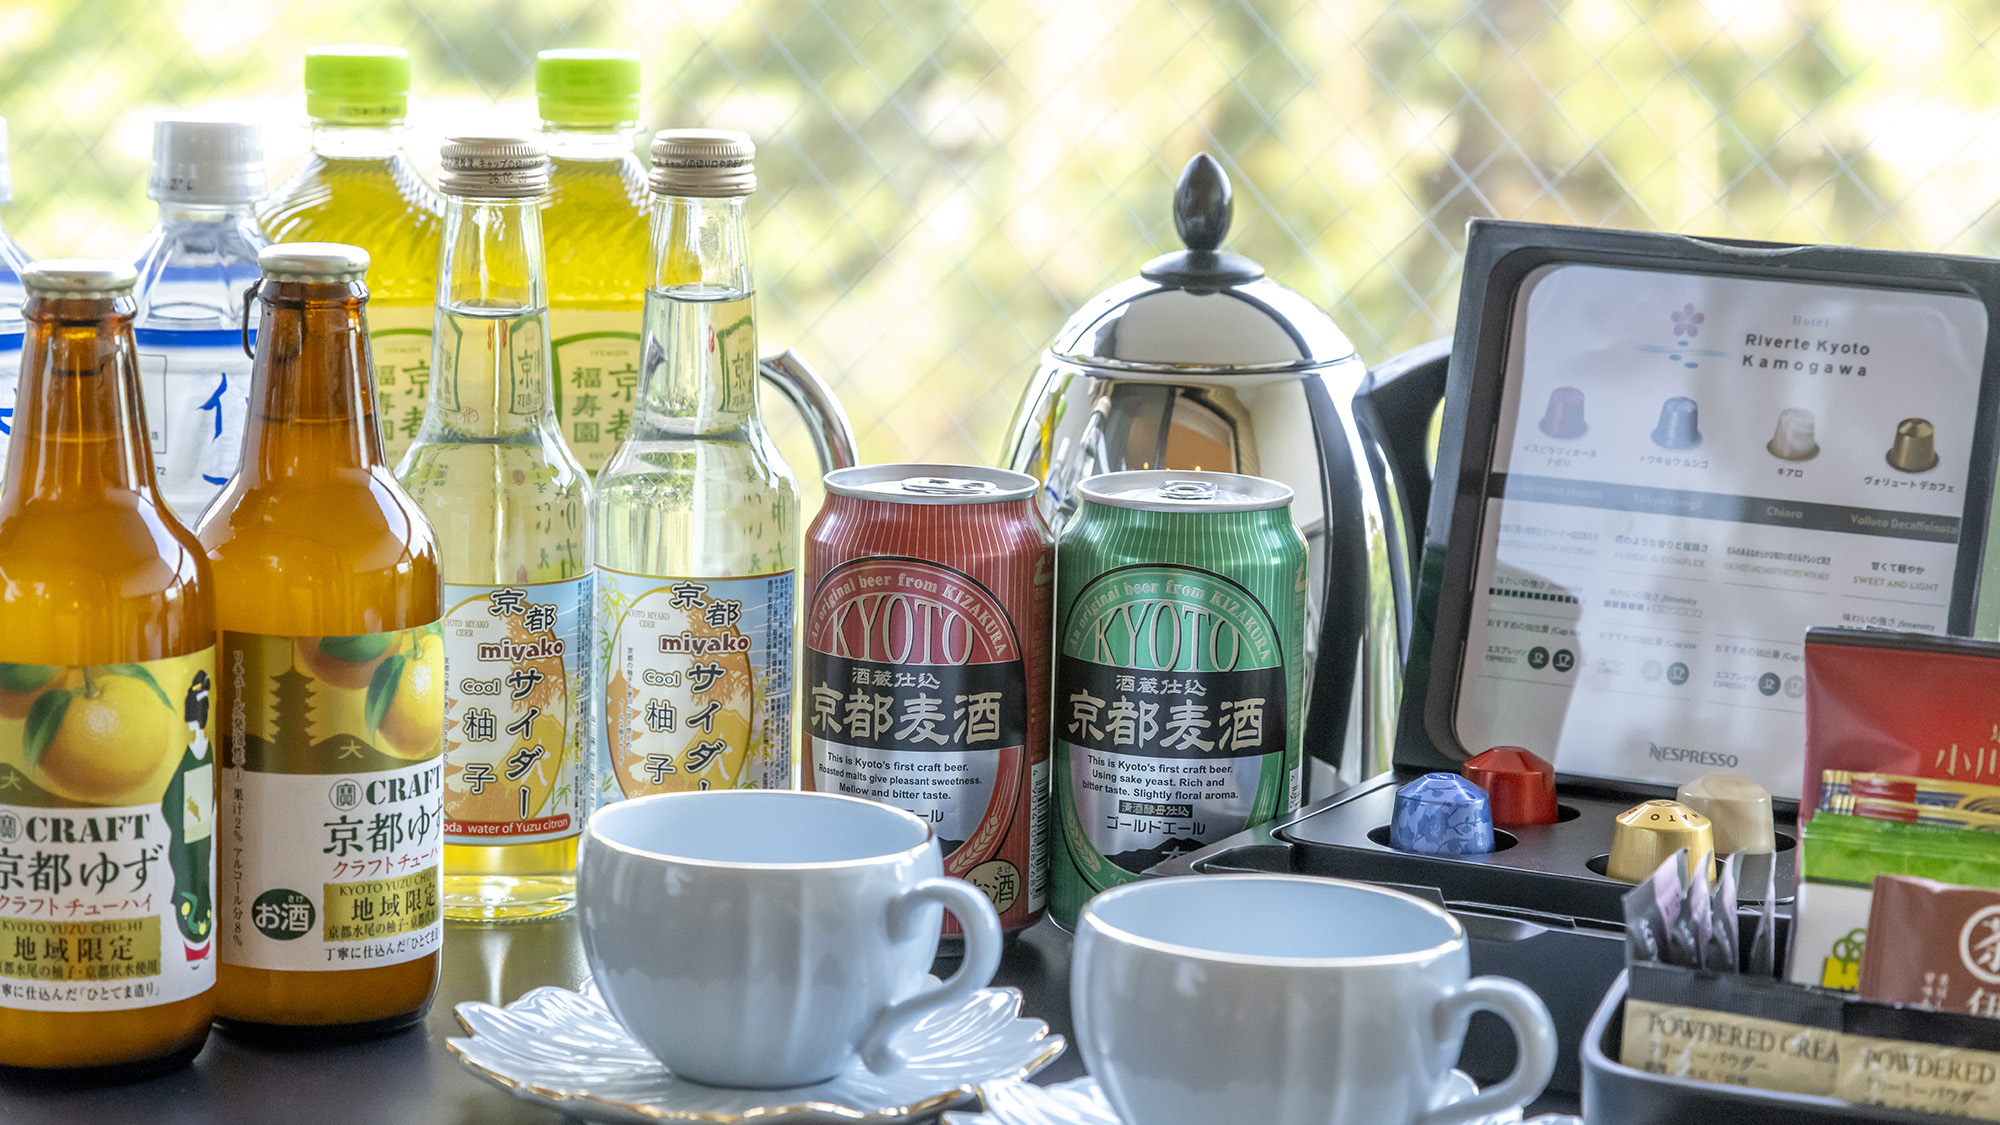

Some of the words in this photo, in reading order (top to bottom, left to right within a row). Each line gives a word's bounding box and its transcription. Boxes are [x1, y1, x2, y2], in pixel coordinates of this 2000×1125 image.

[1745, 334, 1812, 352] Riverte
[1815, 338, 1871, 357] Kyoto
[1742, 355, 1868, 378] Kamogawa
[1640, 455, 1681, 466] トウキョウ
[1682, 459, 1709, 469] ルンゴ
[1776, 466, 1804, 478] キアロ
[1864, 475, 1918, 490] ヴォリュート
[1920, 481, 1955, 494] デカフェ
[1766, 505, 1804, 520] Chiaro
[1850, 514, 1889, 529] Volluto
[1853, 575, 1884, 587] SWEET
[1888, 580, 1908, 590] AND
[1910, 580, 1939, 592] LIGHT
[490, 588, 556, 633] 京都
[672, 583, 740, 627] 京都
[810, 620, 822, 644] An
[818, 579, 854, 621] original
[859, 573, 892, 589] beer
[897, 572, 938, 594] from
[942, 583, 1007, 658] KIZAKURA
[465, 620, 489, 630] MIYAKO
[639, 620, 656, 628] CIDER
[647, 612, 670, 621] MIYAKO
[1069, 630, 1080, 650] An
[1078, 585, 1121, 628] original
[1124, 581, 1160, 596] beer
[1165, 580, 1205, 599] from
[1210, 589, 1272, 663] KIZAKURA
[456, 629, 474, 637] CIDER
[831, 593, 974, 665] KYOTO
[1093, 601, 1241, 672] KYOTO
[480, 639, 564, 661] miyako
[661, 633, 750, 655] miyako
[462, 680, 500, 694] Cool
[644, 670, 679, 685] Cool
[852, 666, 941, 690] 酒蔵仕込
[1115, 674, 1208, 696] 酒蔵仕込
[811, 681, 1002, 746] 京都麦酒
[1068, 689, 1266, 751] 京都麦酒
[465, 709, 496, 793] 柚子
[507, 668, 544, 819] サイダー
[646, 700, 675, 784] 柚子
[828, 751, 844, 764] This
[845, 755, 853, 766] is
[855, 758, 891, 772] Kyoto's
[893, 761, 915, 773] first
[917, 762, 941, 773] craft
[944, 762, 970, 773] beer.
[1088, 755, 1105, 767] This
[1107, 758, 1116, 768] is
[1118, 759, 1156, 773] Kyoto's
[1158, 764, 1180, 774] first
[1183, 764, 1207, 775] craft
[1210, 764, 1234, 775] beer.
[1649, 742, 1739, 768] NESPRESSO
[366, 765, 441, 806] CRAFT
[819, 763, 844, 779] Roasted
[845, 769, 867, 782] malts
[869, 774, 888, 786] give
[890, 775, 930, 788] pleasant
[932, 775, 982, 786] sweetness.
[1092, 769, 1117, 784] Using
[1119, 774, 1143, 785] sake
[1145, 777, 1177, 788] yeast.
[1179, 777, 1203, 788] Rich
[1206, 778, 1225, 788] and
[839, 783, 869, 796] Mellow
[871, 788, 889, 798] and
[892, 787, 920, 801] bitter
[923, 790, 951, 800] taste.
[1082, 781, 1103, 793] bitter
[1105, 785, 1131, 798] taste.
[1133, 787, 1172, 801] Slightly
[1175, 789, 1202, 800] floral
[1205, 790, 1239, 800] aroma.
[468, 823, 499, 836] water
[502, 821, 514, 835] of
[516, 821, 542, 835] Yuzu
[543, 816, 569, 832] citron
[906, 809, 944, 824] ール
[1107, 815, 1206, 836] ゴールドエール
[26, 813, 150, 843] CRAFT
[332, 846, 440, 879] クラフトチューハ
[340, 882, 383, 896] KYOTO
[385, 877, 412, 893] YUZU
[351, 882, 436, 922] 地域限定
[2, 922, 46, 935] KYOTO
[51, 922, 86, 936] YUZU
[90, 920, 143, 935] CHU-HI
[255, 903, 310, 933] お酒
[13, 935, 133, 962] 地域限定
[0, 959, 157, 979] 都水尾の柚子・京都伏水使用
[1649, 1013, 1776, 1053] POWDERED
[1864, 1048, 1997, 1086] POWDERED
